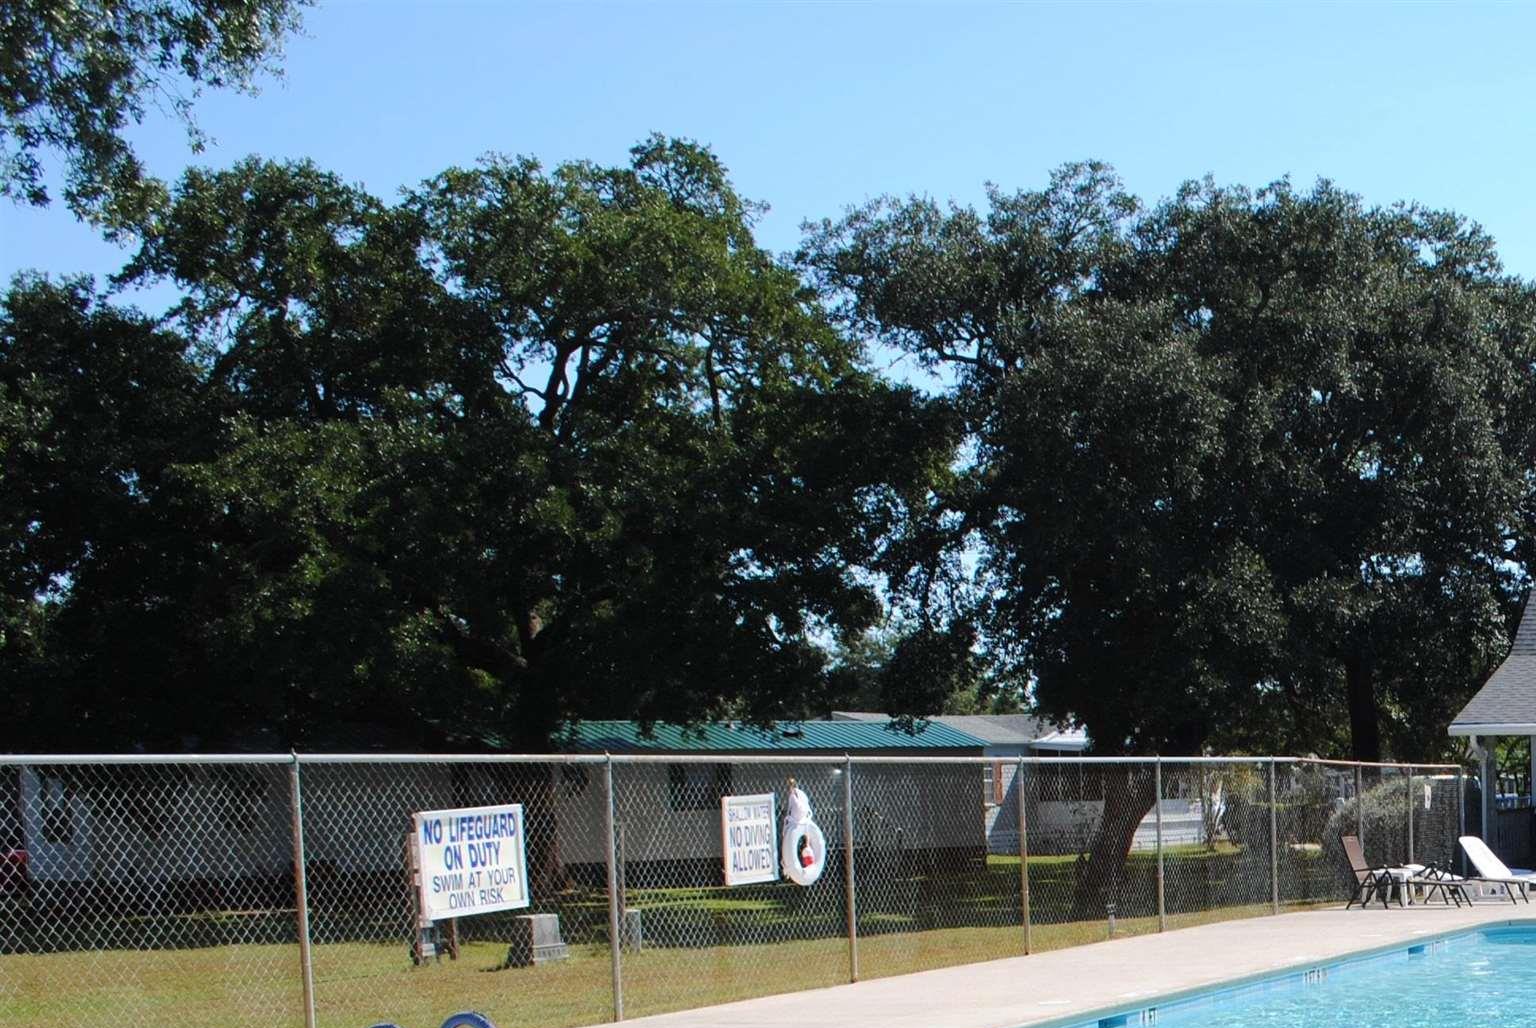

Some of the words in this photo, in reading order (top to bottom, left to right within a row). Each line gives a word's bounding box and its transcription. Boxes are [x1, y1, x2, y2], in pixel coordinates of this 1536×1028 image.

[423, 818, 443, 845] NO
[449, 812, 517, 842] LIFEGUARD
[729, 826, 743, 848] NO
[745, 824, 770, 847] DIVING
[444, 844, 464, 871] ON
[468, 841, 500, 868] DUTY
[733, 849, 771, 873] ALLOWED
[433, 873, 463, 893] SWIM
[468, 871, 482, 889] AT
[488, 867, 516, 886] YOUR
[449, 891, 475, 909] OWN
[480, 887, 504, 905] RISK
